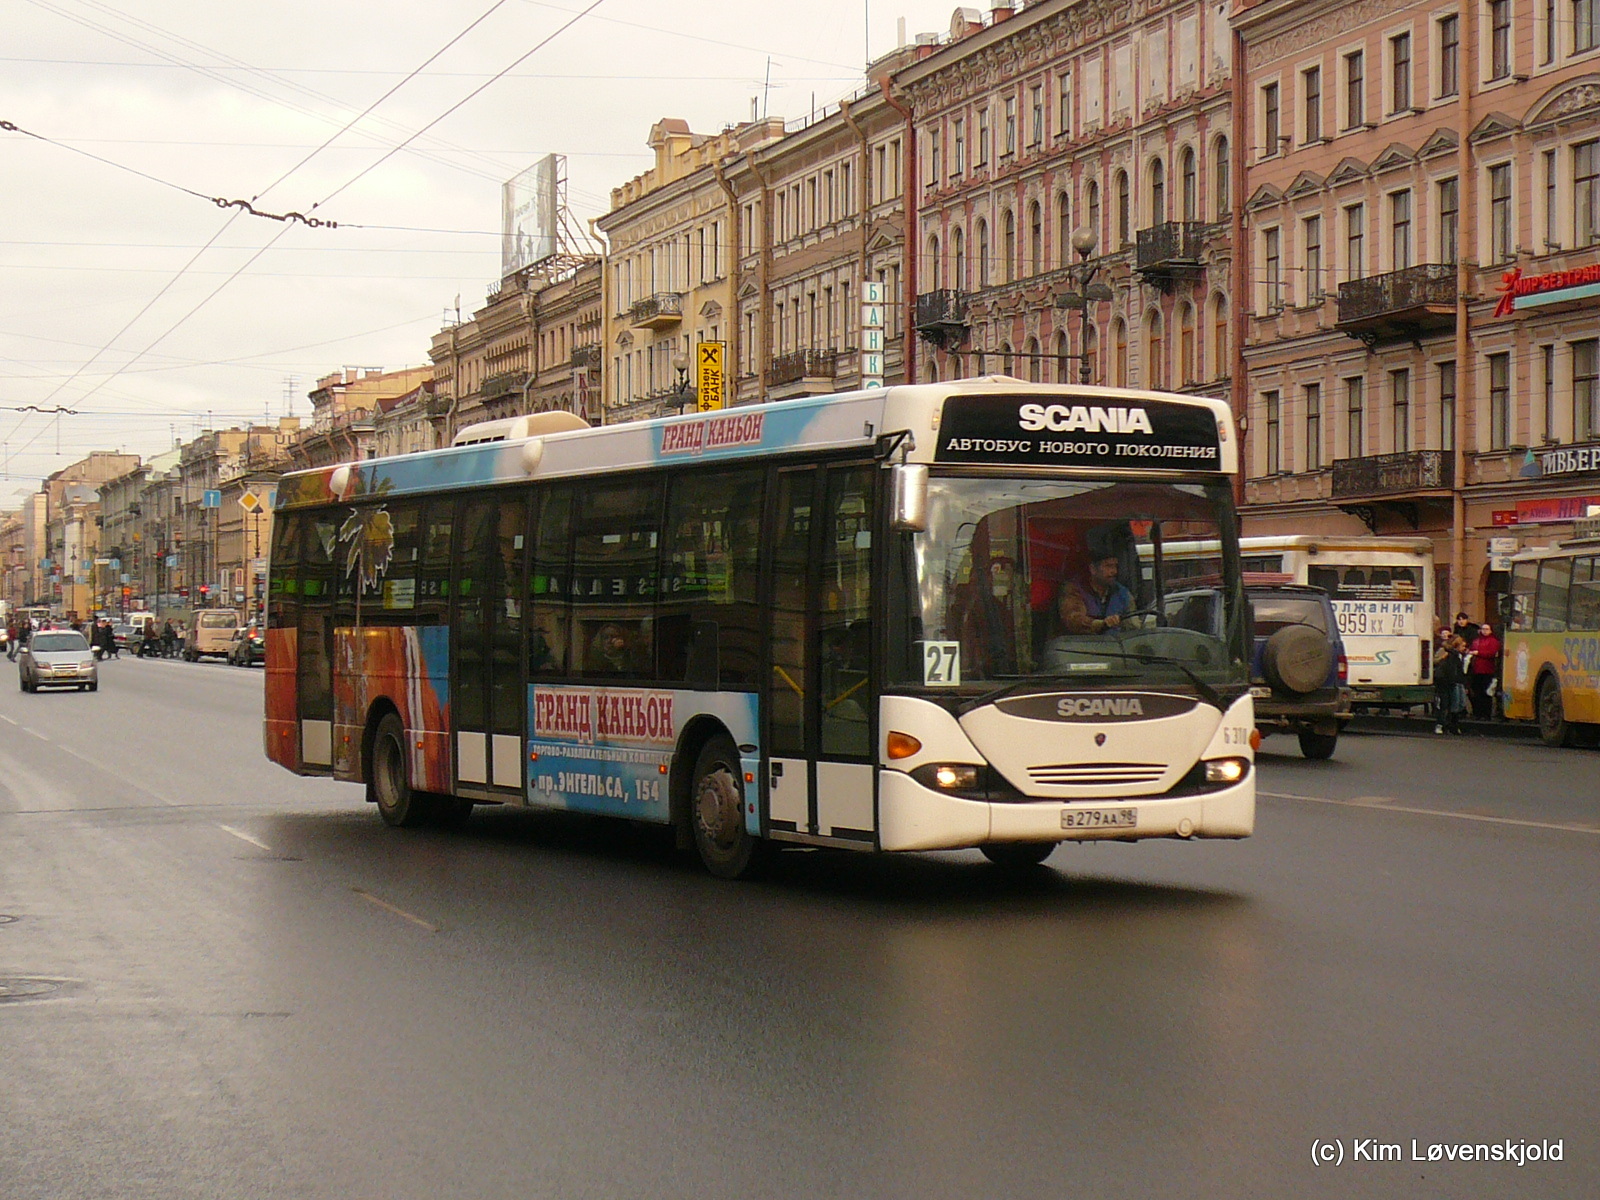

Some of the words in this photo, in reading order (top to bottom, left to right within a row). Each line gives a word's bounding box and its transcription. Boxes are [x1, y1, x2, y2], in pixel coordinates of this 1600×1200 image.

[1515, 277, 1540, 295] МИР
[1541, 272, 1564, 290] БЕЗ
[1568, 264, 1600, 285] ГРАН
[711, 369, 720, 401] БАНК
[661, 421, 704, 451] ГРАНД
[707, 413, 764, 446] КАНЬОН
[1018, 403, 1153, 434] SCANIA
[946, 438, 1032, 453] АВТОБУС
[1039, 441, 1110, 455] НОВОГО
[1115, 443, 1217, 459] ПОКОЛЕНИЯ
[1338, 613, 1367, 633] 959
[926, 645, 957, 682] 27
[535, 693, 592, 741] ГРАНД
[596, 695, 673, 739] КАНЬОН
[1057, 698, 1144, 716] SCANIA
[635, 779, 659, 801] 154
